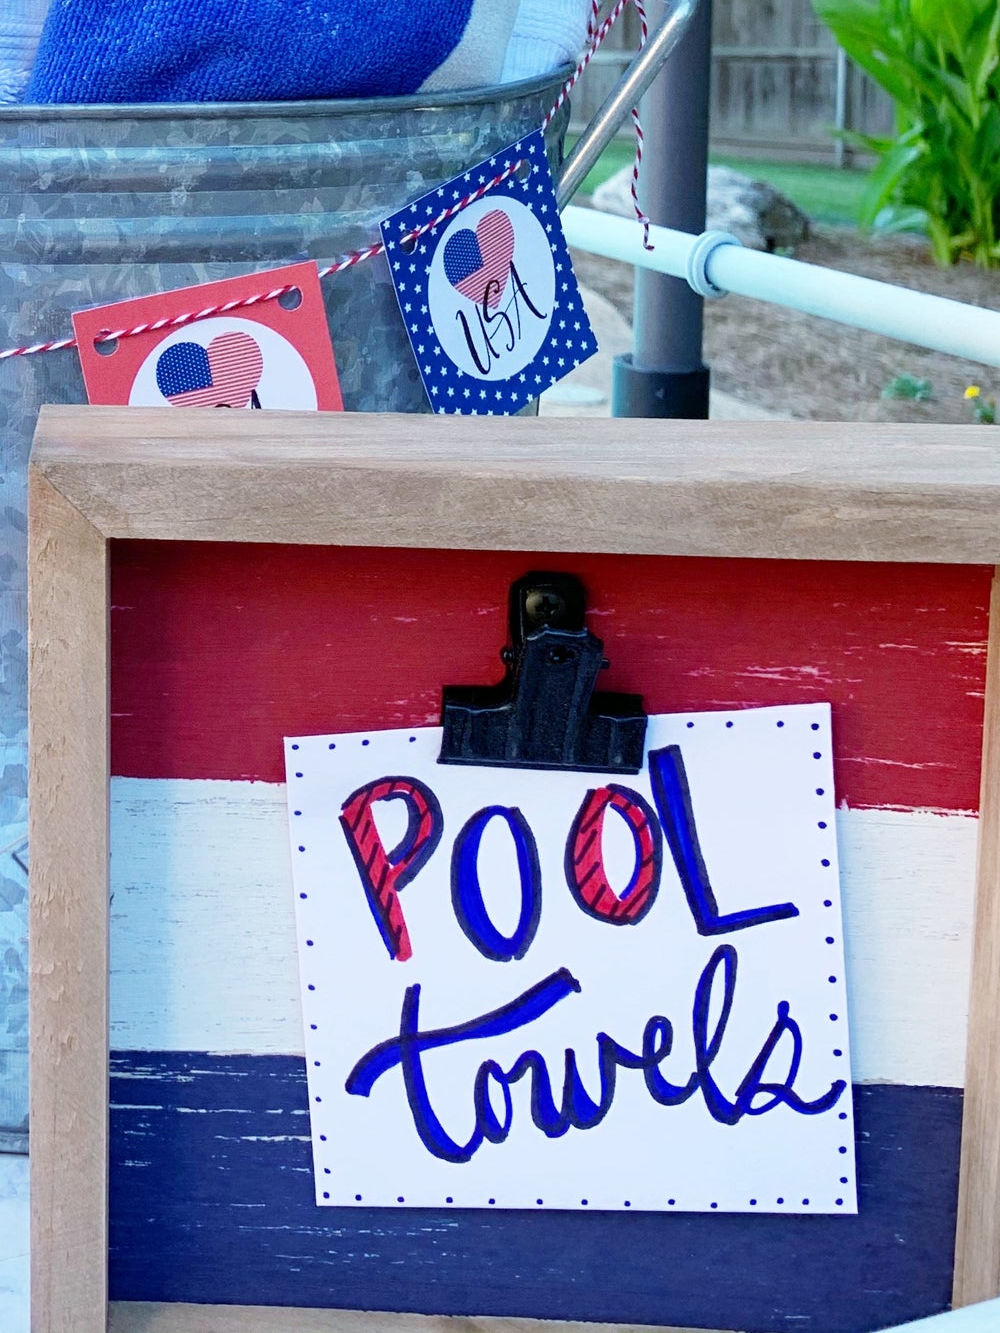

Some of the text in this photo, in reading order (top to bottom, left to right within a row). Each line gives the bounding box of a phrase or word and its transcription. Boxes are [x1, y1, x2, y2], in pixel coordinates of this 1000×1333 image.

[455, 259, 548, 375] USA
[339, 744, 800, 962] POOL
[345, 944, 846, 1164] towels
